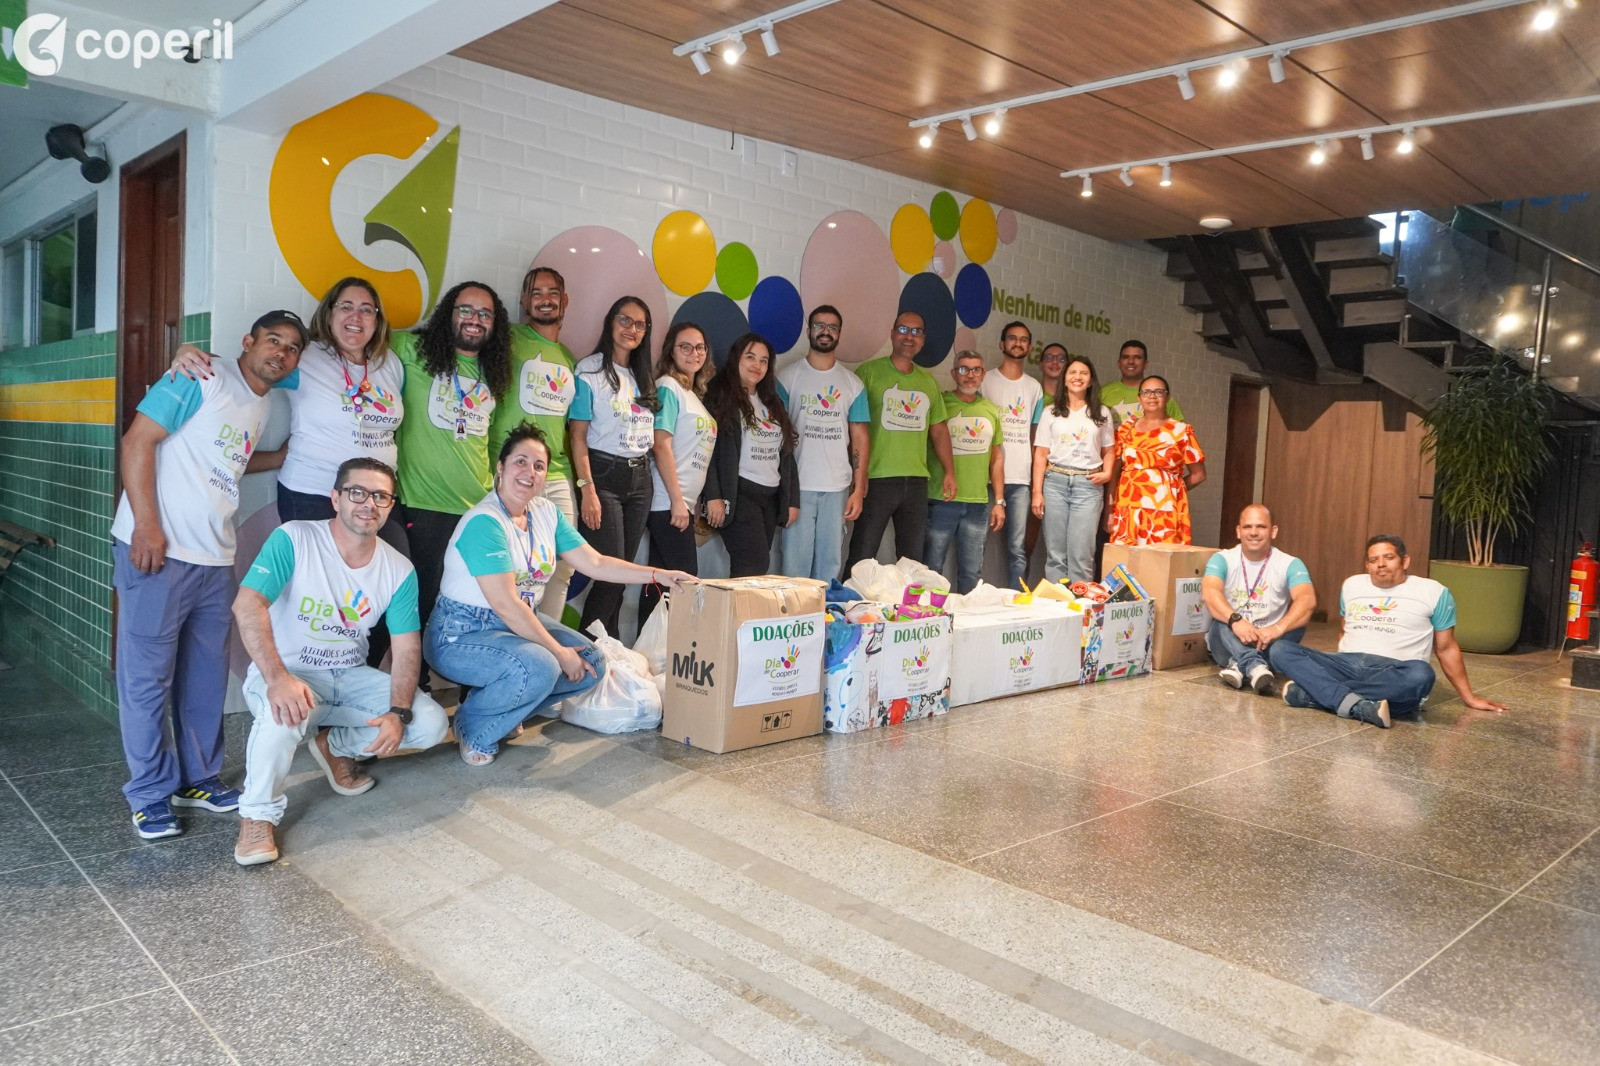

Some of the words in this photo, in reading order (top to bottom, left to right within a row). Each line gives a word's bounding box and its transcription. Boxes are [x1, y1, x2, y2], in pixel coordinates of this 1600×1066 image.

[992, 286, 1060, 324] Nenhum
[1064, 304, 1082, 329] de
[1086, 310, 1111, 335] nós
[527, 371, 546, 385] Dia
[535, 386, 567, 403] Cooperar
[800, 394, 818, 404] Dia
[807, 406, 840, 417] Cooperar
[892, 409, 921, 420] Cooperar
[219, 424, 243, 446] Dia
[957, 435, 985, 443] Cooperar
[300, 597, 333, 616] Dia
[1111, 604, 1143, 620] DOAÇÕES
[298, 613, 309, 622] de
[1354, 612, 1397, 623] Cooperar
[753, 620, 814, 643] DOAÇÕES
[894, 623, 941, 644] DOAÇÕES
[1002, 626, 1043, 645] DOAÇÕES
[765, 658, 781, 669] Dia
[902, 658, 915, 667] Dia
[770, 669, 800, 678] Cooperar
[906, 667, 930, 676] Cooperar
